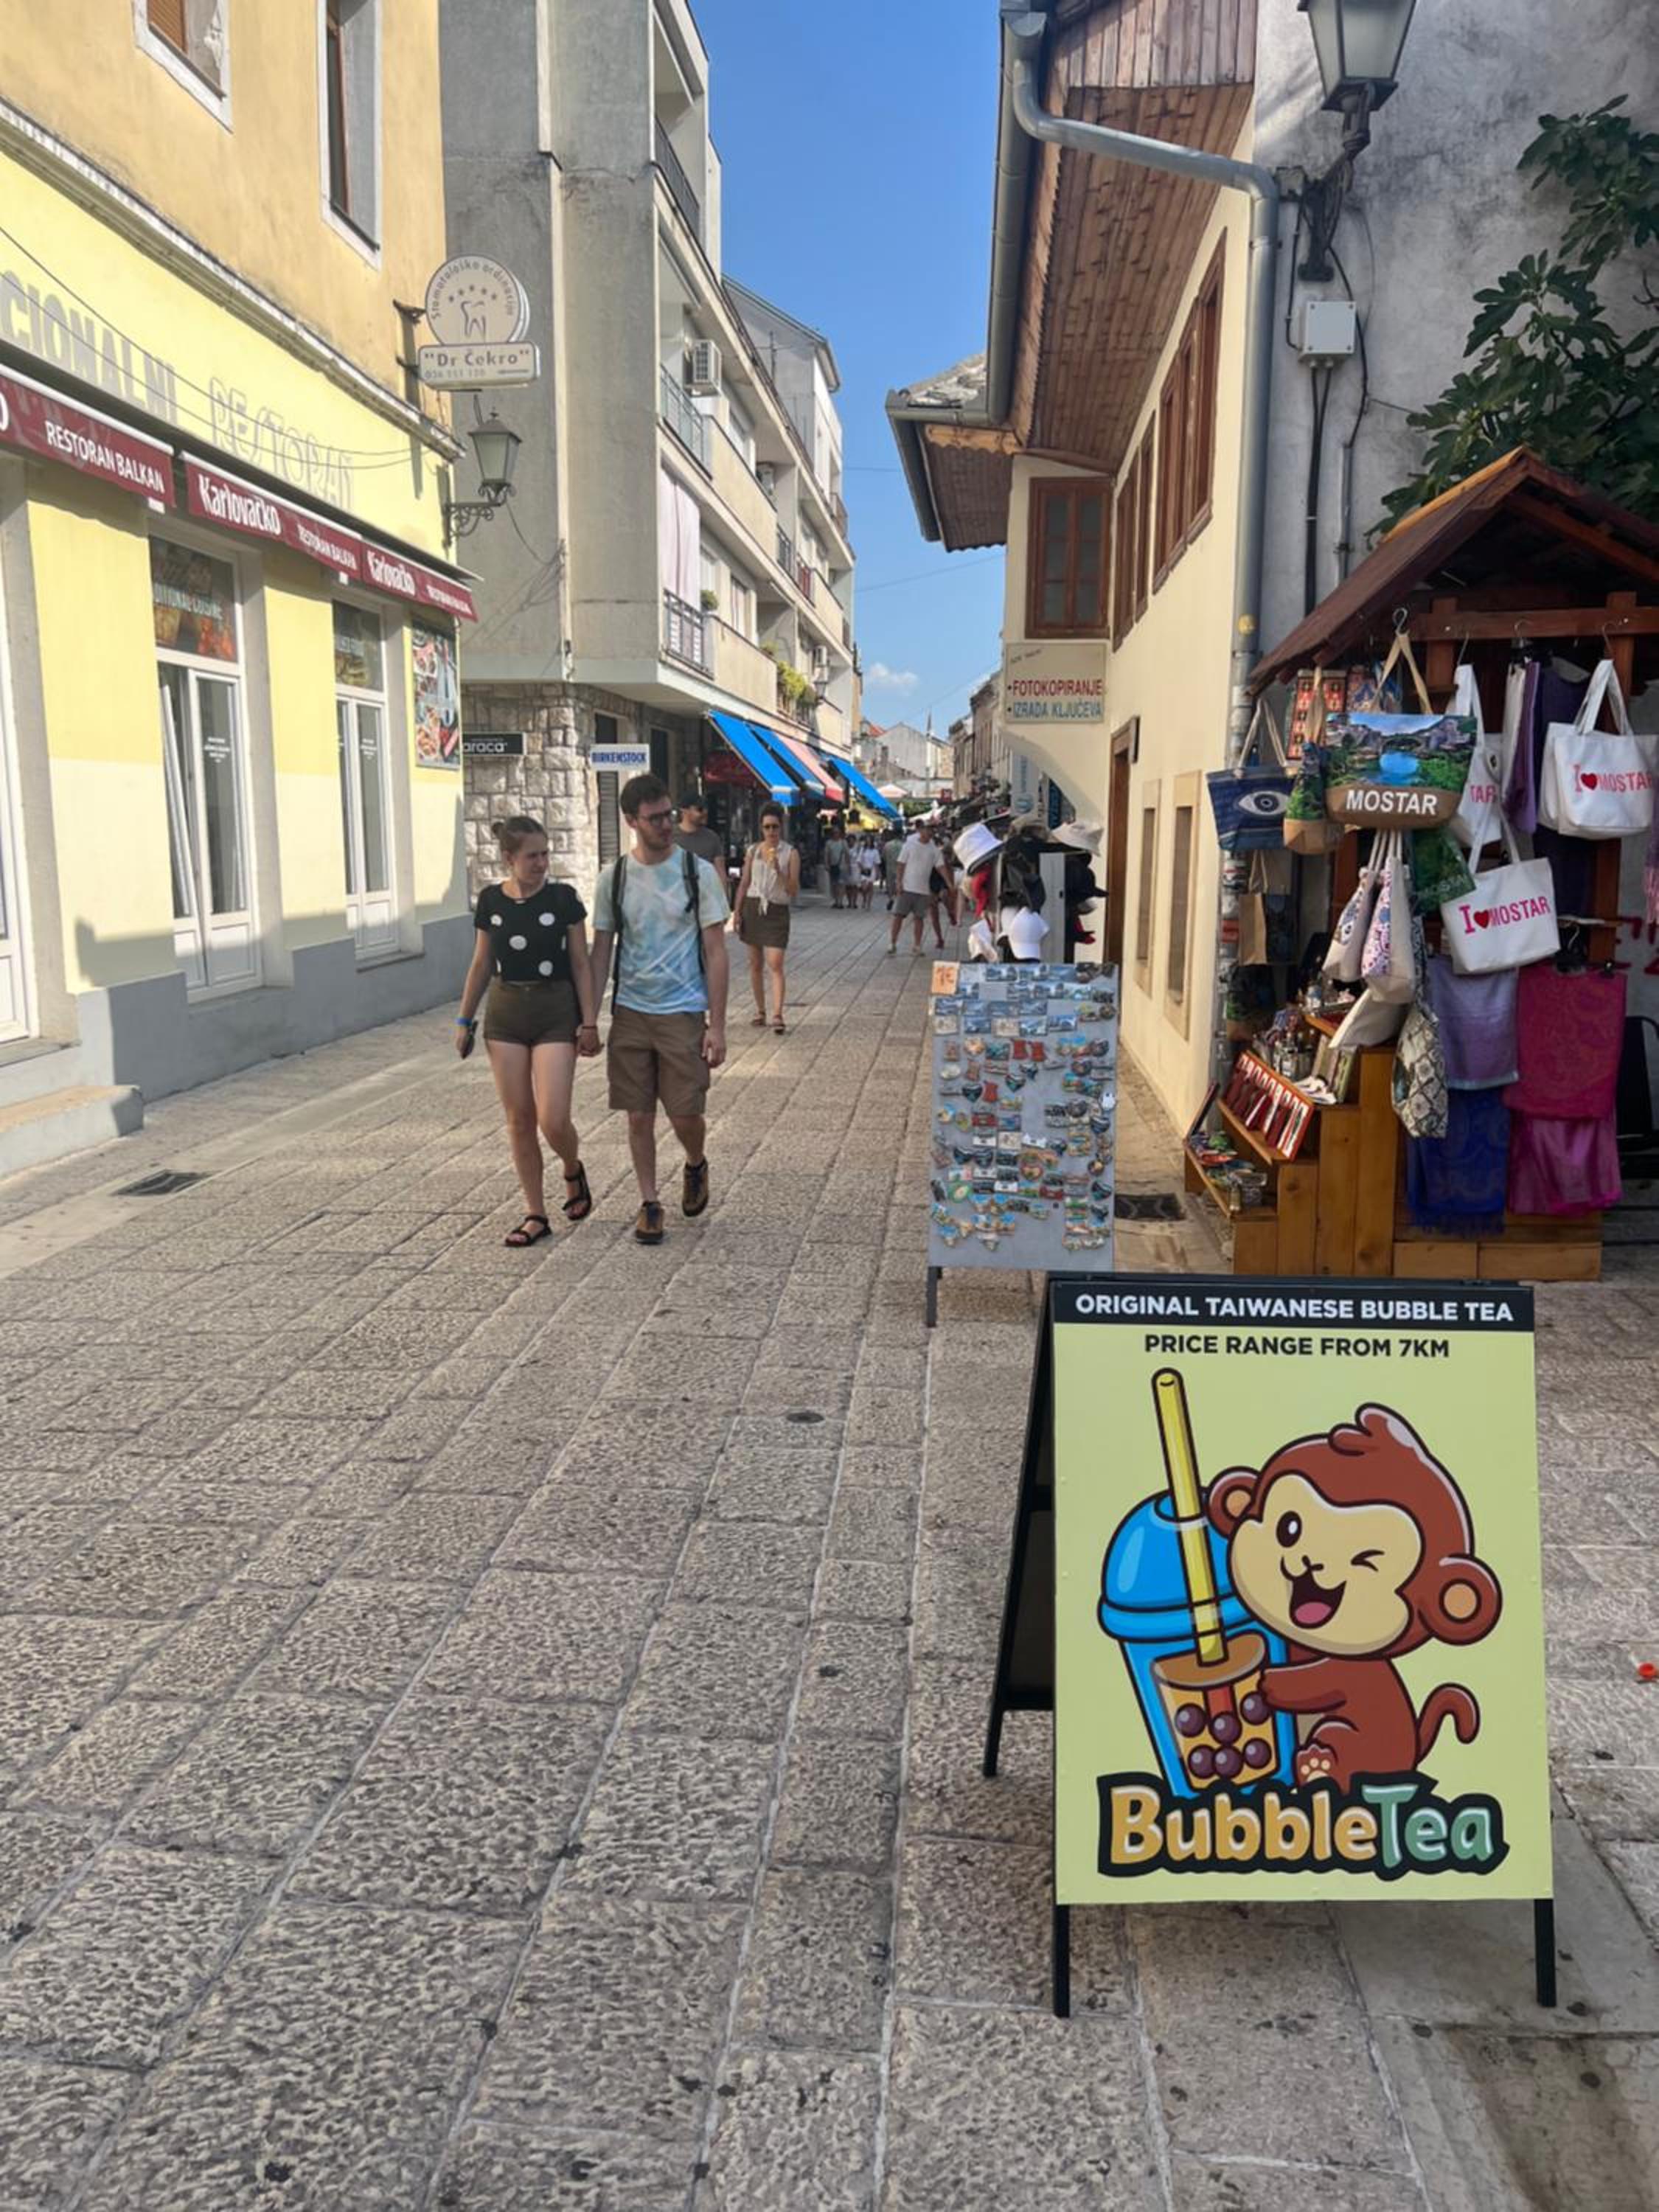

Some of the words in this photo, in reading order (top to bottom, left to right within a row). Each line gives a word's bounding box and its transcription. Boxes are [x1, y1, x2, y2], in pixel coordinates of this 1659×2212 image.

[45, 420, 116, 473] RESTORAN
[115, 453, 165, 494] BALKAN
[198, 473, 281, 536] Karlovačko
[591, 751, 647, 764] BIRKENSTOCK
[1346, 790, 1437, 815] MOSTAR
[1458, 905, 1475, 933] I
[1488, 896, 1551, 927] MOSTAR
[1075, 1294, 1199, 1315] ORIGINAL
[1206, 1298, 1354, 1318] TAIWANESE
[1360, 1300, 1458, 1320] BUBBLE
[1464, 1303, 1514, 1321] TEA
[1145, 1335, 1218, 1354] PRICE
[1225, 1336, 1312, 1355] RANGE
[1321, 1338, 1391, 1357] FROM
[1399, 1339, 1450, 1357] 7KM
